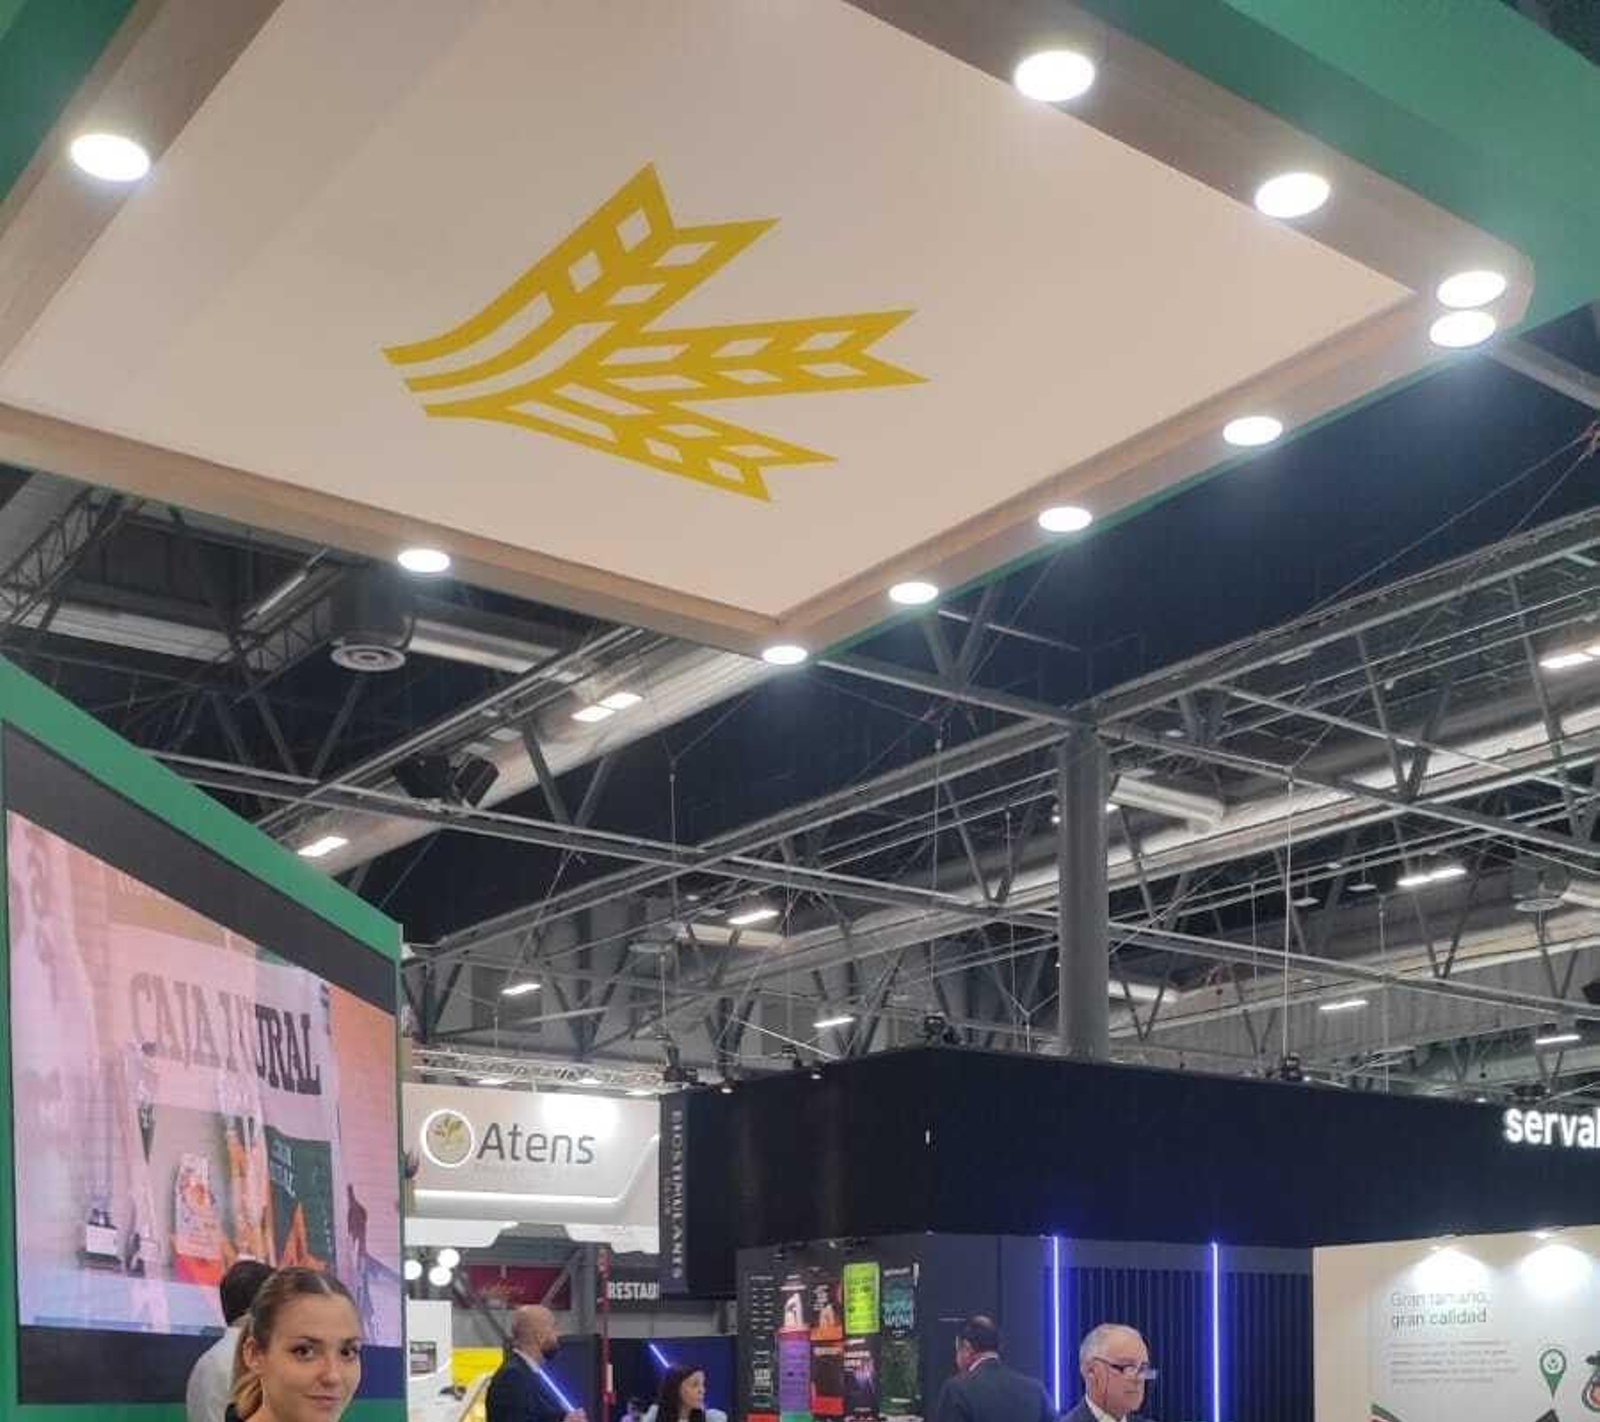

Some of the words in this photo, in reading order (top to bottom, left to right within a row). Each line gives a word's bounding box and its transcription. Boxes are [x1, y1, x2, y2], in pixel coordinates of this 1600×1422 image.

[476, 1122, 597, 1165] Atens
[1391, 1292, 1425, 1308] Gran
[1391, 1314, 1425, 1329] gran
[1429, 1307, 1487, 1325] calidad
